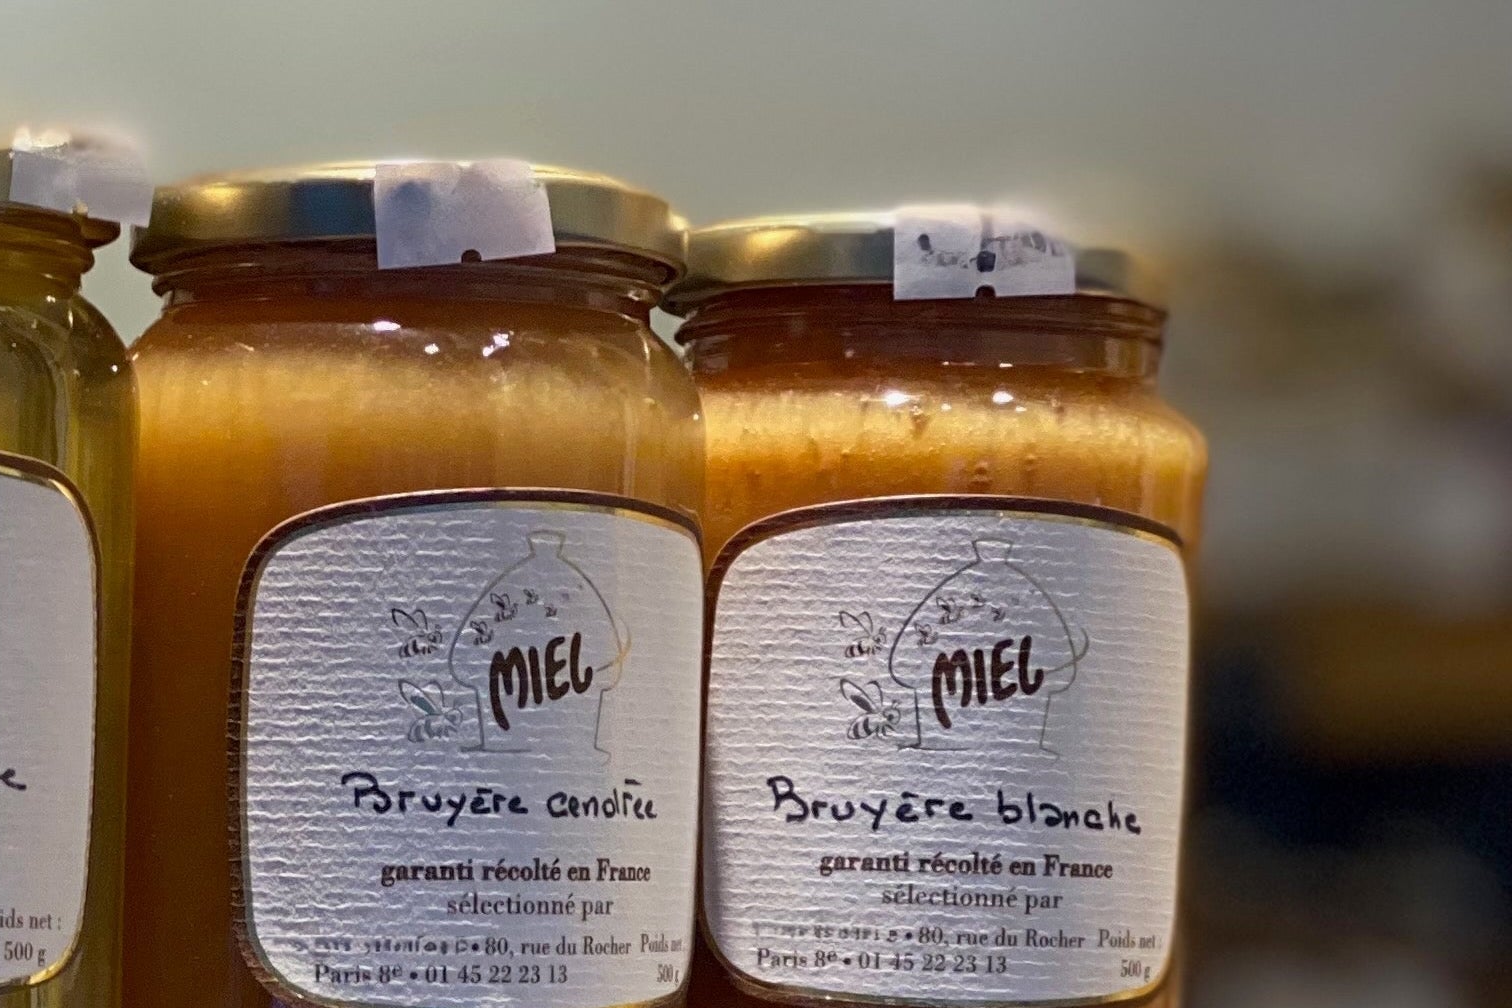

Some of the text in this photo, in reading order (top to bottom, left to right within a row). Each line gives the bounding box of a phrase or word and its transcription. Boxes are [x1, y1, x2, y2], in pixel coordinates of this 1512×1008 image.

[489, 631, 592, 730] MIEL
[932, 635, 1045, 729] MIEL
[997, 792, 1141, 835] blanche
[381, 857, 651, 887] garanti récolté en France
[820, 853, 1113, 878] garanti récolté en France
[447, 893, 613, 921] sélectionné par
[882, 886, 1063, 915] sélectionné par
[4, 941, 33, 960] 500
[521, 943, 549, 955] rue
[556, 936, 577, 956] du
[583, 939, 631, 956] Rocher
[957, 932, 988, 948] rue
[994, 929, 1018, 948] du
[1024, 930, 1085, 948] Rocher
[757, 948, 806, 968] Paris
[859, 952, 881, 970] 01
[921, 954, 945, 972] 22
[953, 955, 976, 973] 23
[988, 956, 1007, 973] 13
[1120, 959, 1141, 977] 500
[314, 963, 567, 984] Paris 01 45 22 23 13
